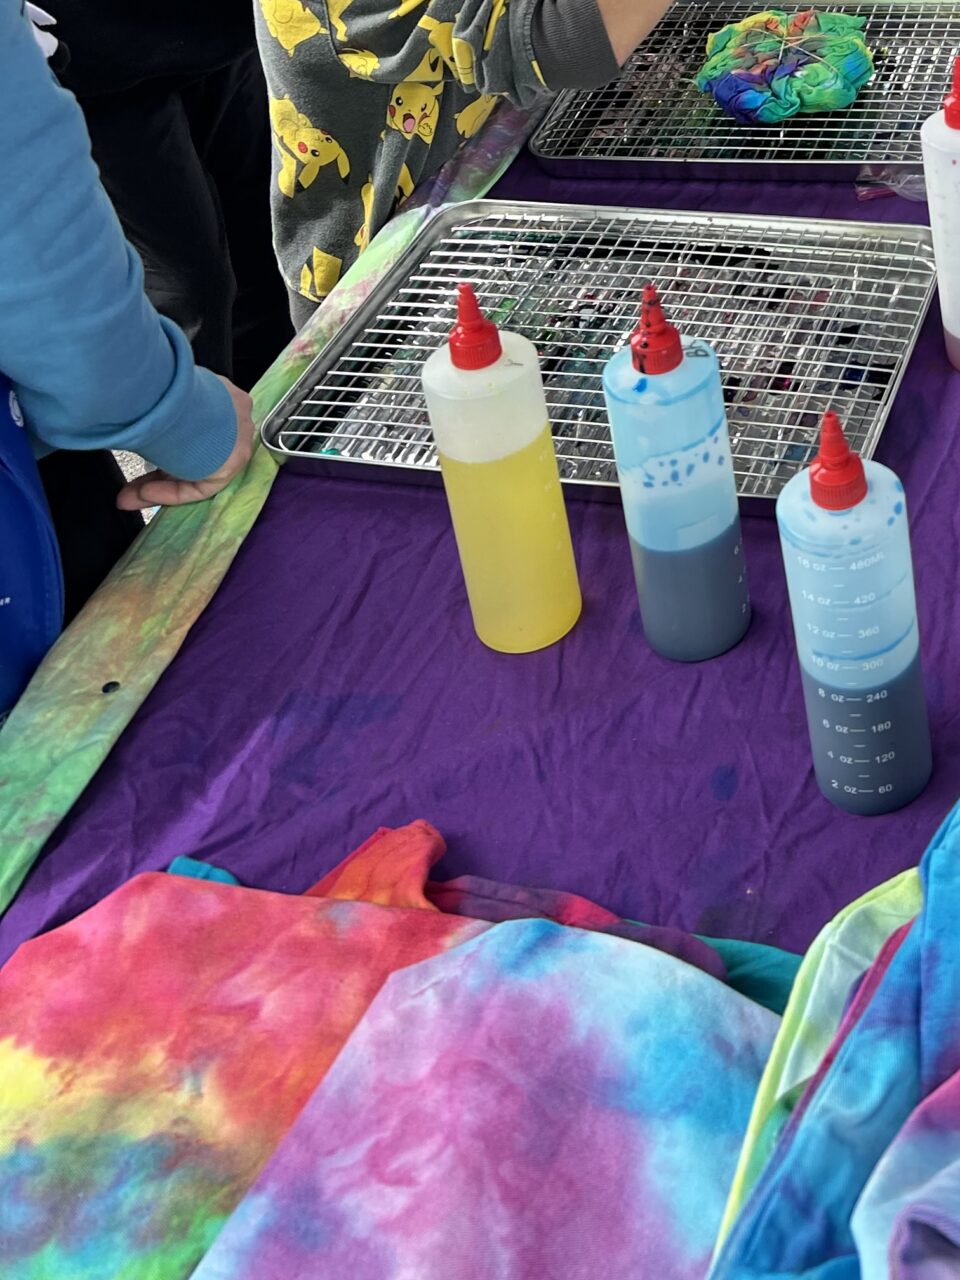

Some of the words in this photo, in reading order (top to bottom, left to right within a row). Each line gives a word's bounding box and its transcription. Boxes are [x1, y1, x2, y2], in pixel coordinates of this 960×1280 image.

[798, 556, 811, 569] 16
[802, 589, 814, 601] 14
[853, 592, 876, 605] 420
[807, 623, 819, 635] 12
[858, 626, 880, 639] 360
[812, 655, 824, 667] 10
[862, 659, 885, 671] 300
[818, 687, 826, 698] 8
[866, 689, 888, 704] 240
[822, 719, 831, 729] 6
[872, 721, 892, 734] 180
[827, 751, 834, 759] 4
[875, 752, 896, 764] 120
[831, 779, 839, 789] 2
[878, 784, 893, 794] 60
